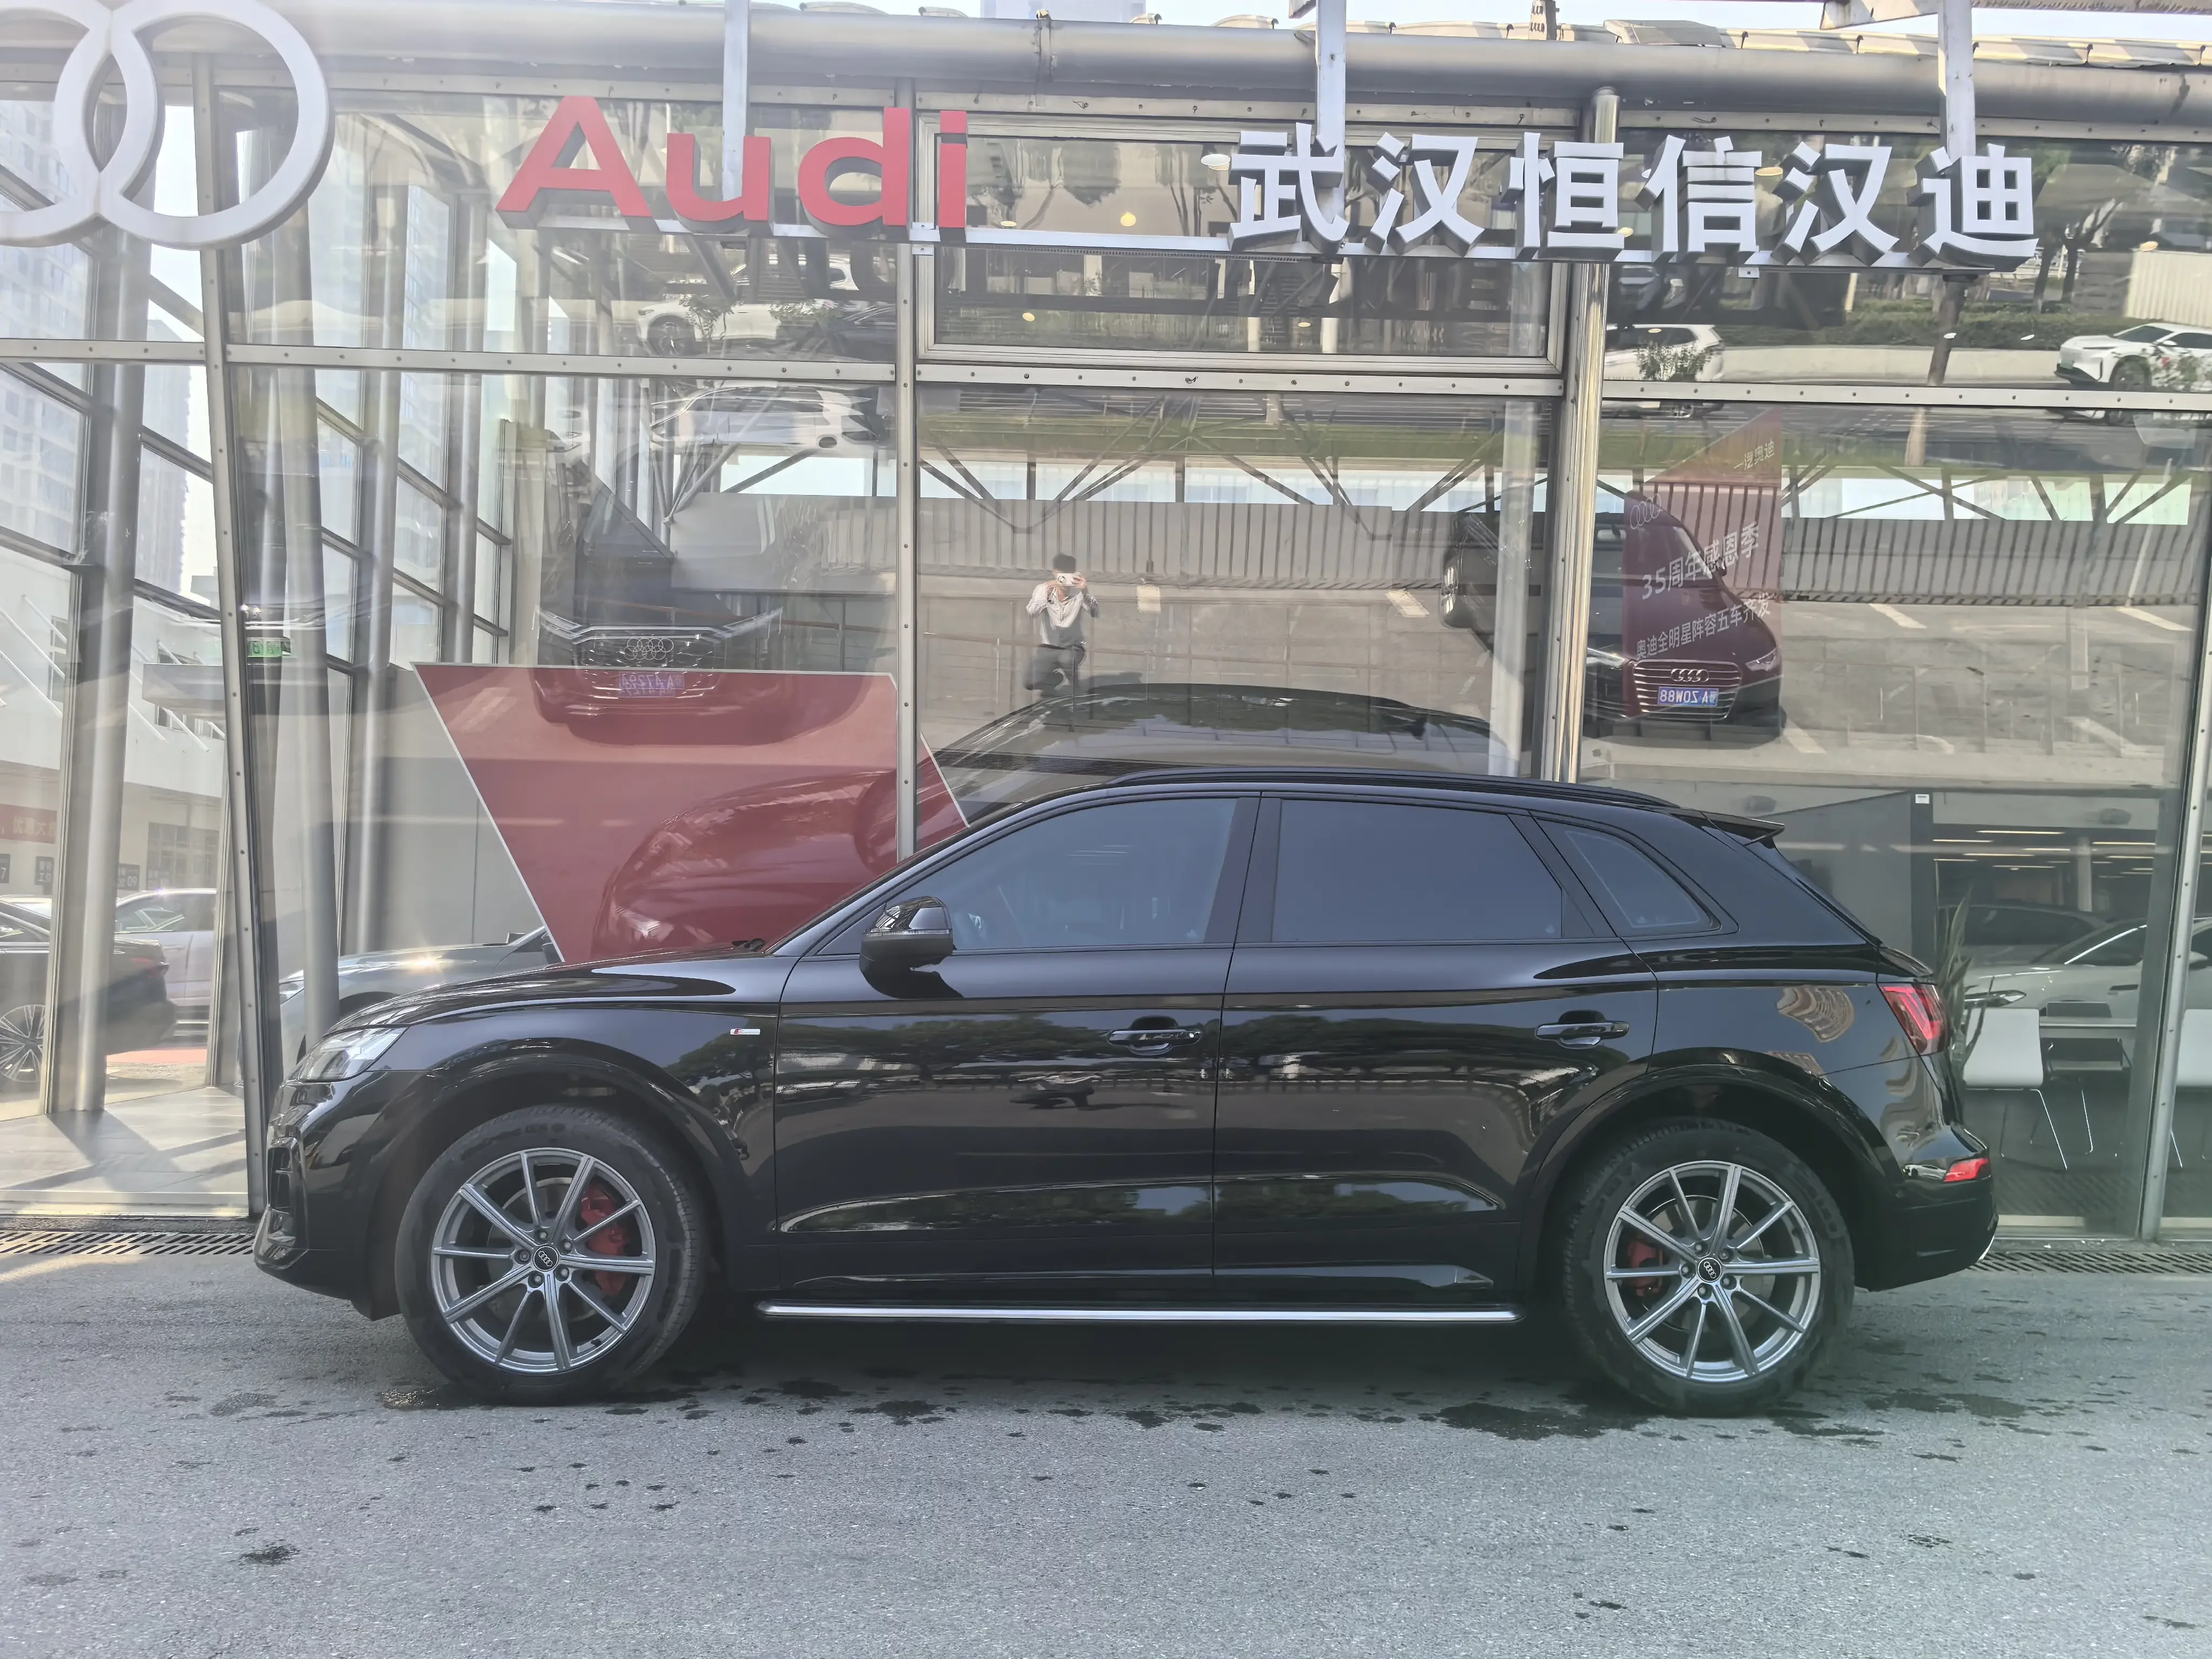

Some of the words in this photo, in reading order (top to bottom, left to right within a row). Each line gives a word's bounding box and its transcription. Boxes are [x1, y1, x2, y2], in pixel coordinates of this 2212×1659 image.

[495, 96, 967, 229] Audi
[1229, 123, 2039, 257] 武汉恒信汉迪
[1734, 439, 1775, 471] 一汽奥迪
[1642, 521, 1759, 600] 35周年感恩季
